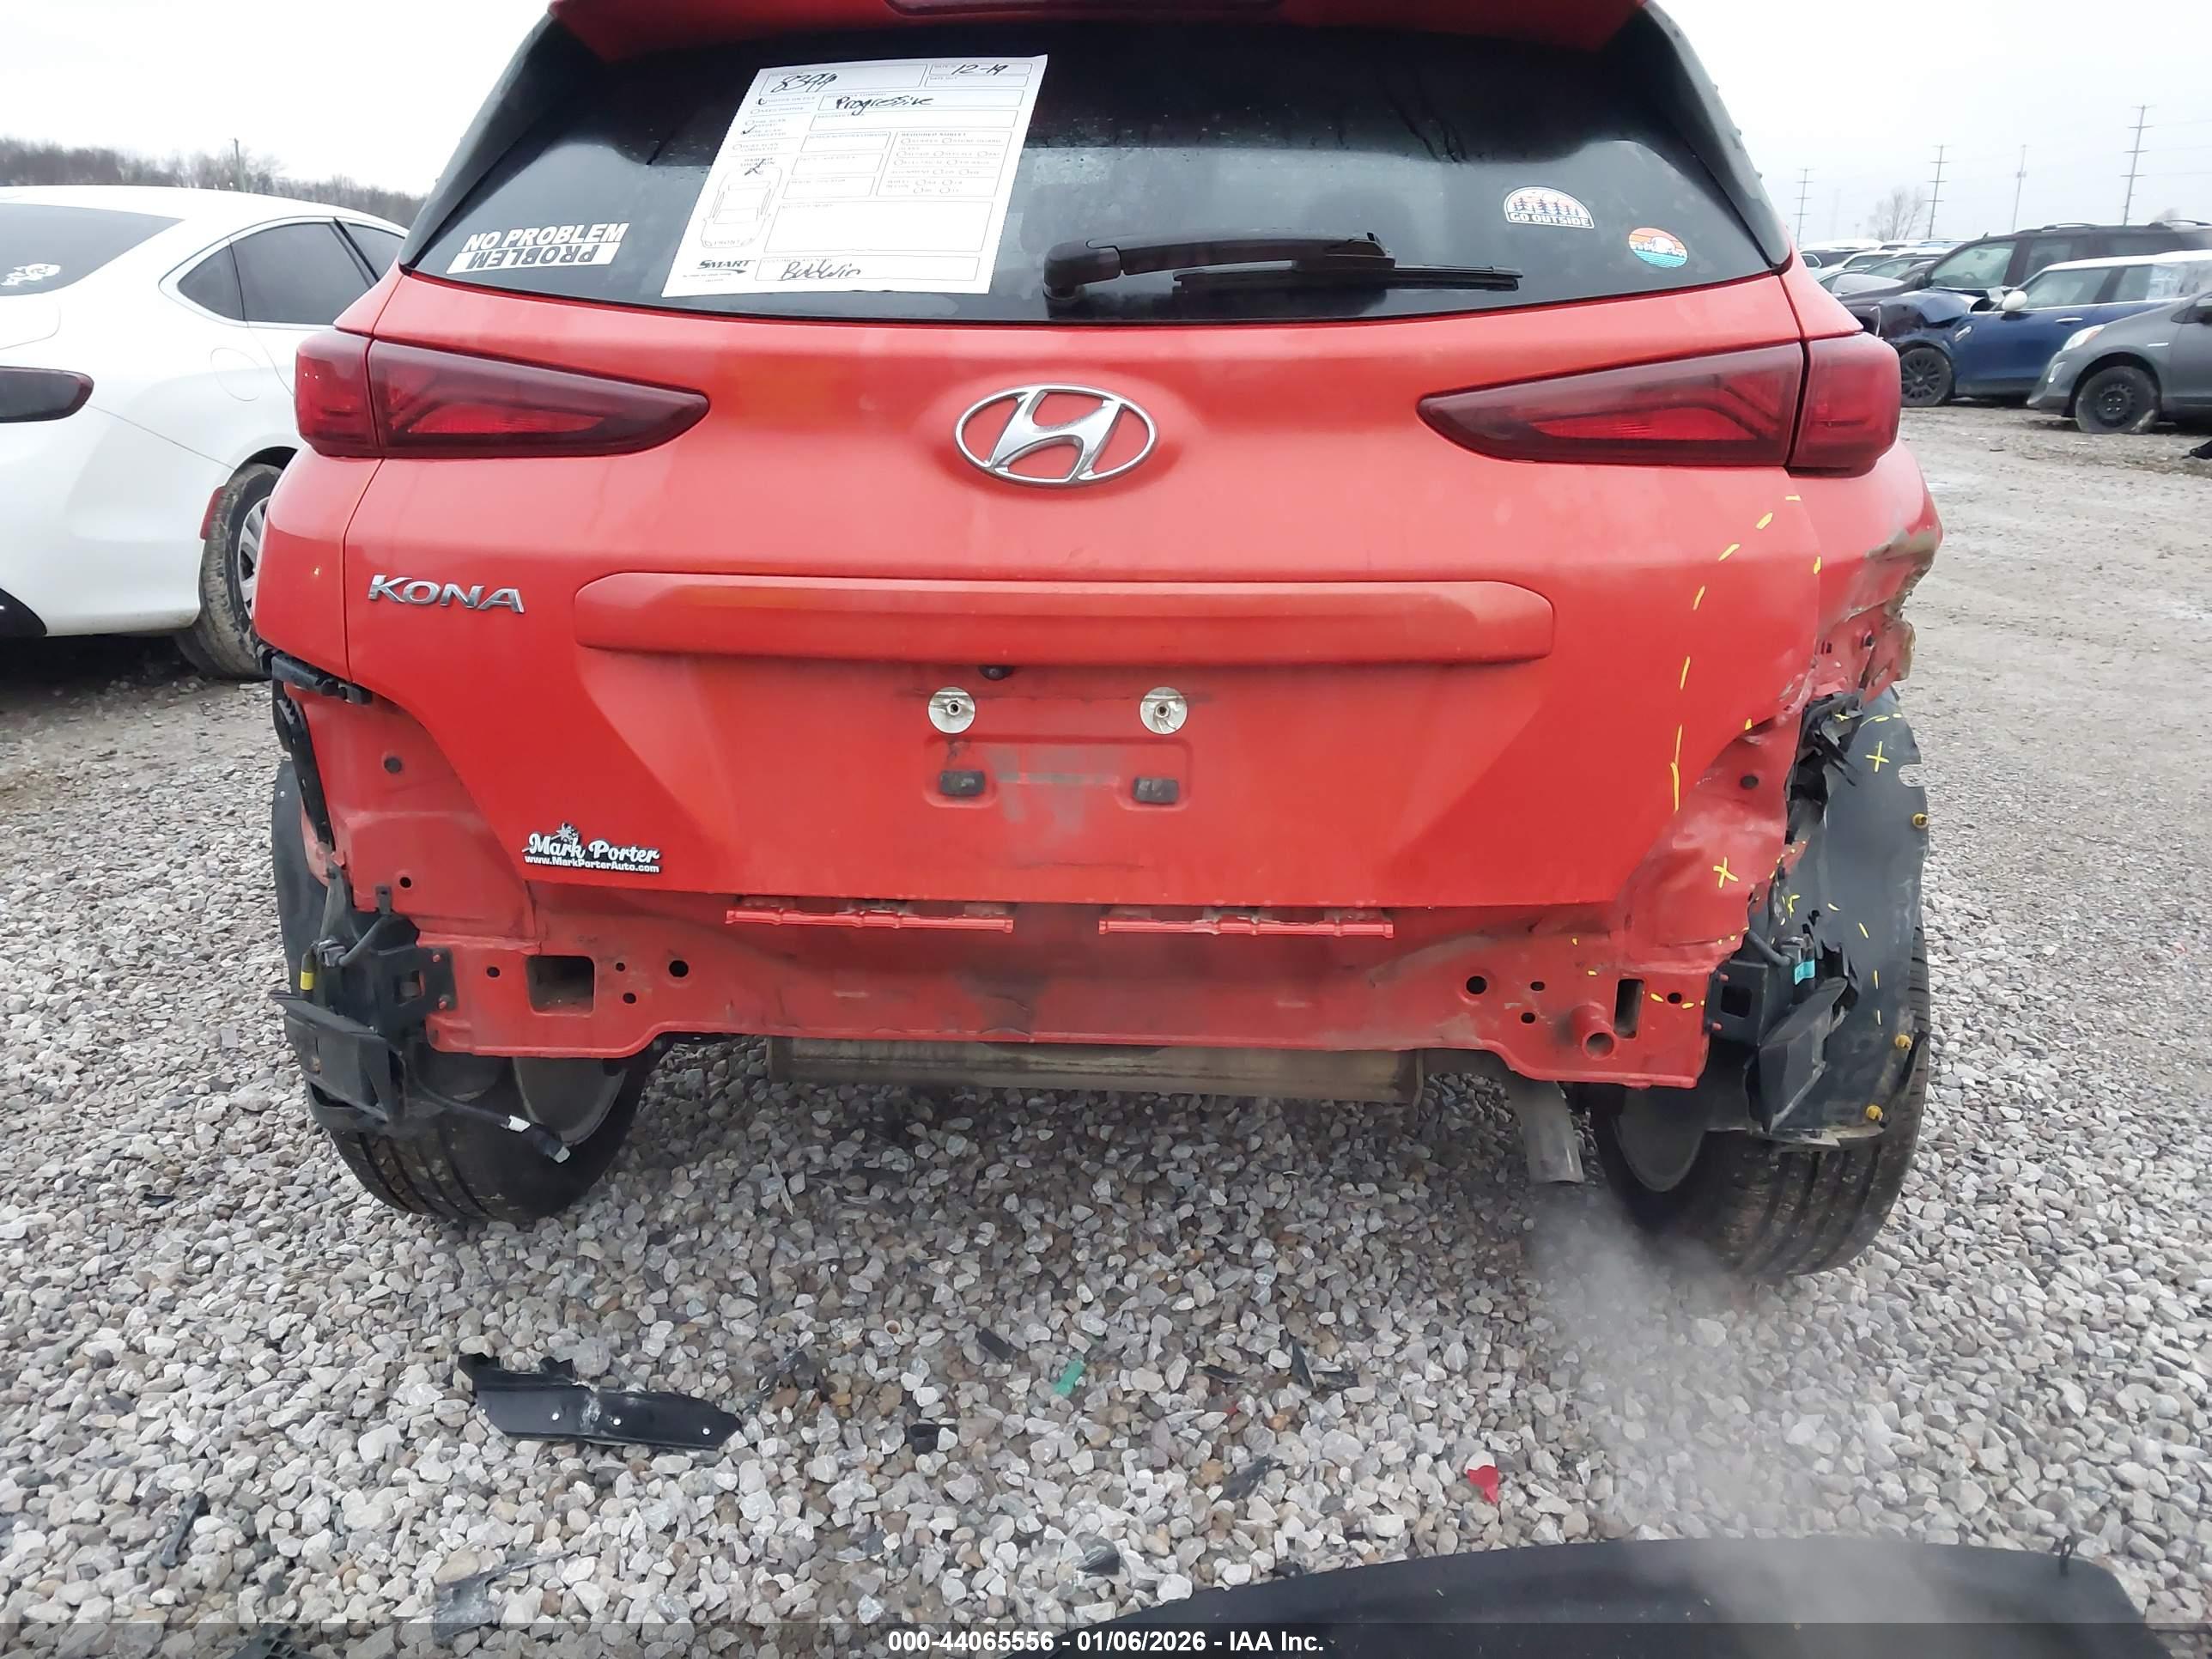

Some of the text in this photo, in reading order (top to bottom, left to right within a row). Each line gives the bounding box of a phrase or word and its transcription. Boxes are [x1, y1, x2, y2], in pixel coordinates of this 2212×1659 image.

[1509, 212, 1590, 226] GO OUTSIDE
[461, 222, 630, 252] NO PROBLEM
[465, 244, 600, 270] PROBLEM
[368, 574, 526, 613] KONA
[522, 833, 660, 864] Mark Porter
[525, 855, 660, 872] www.MarkPorterAuto.com
